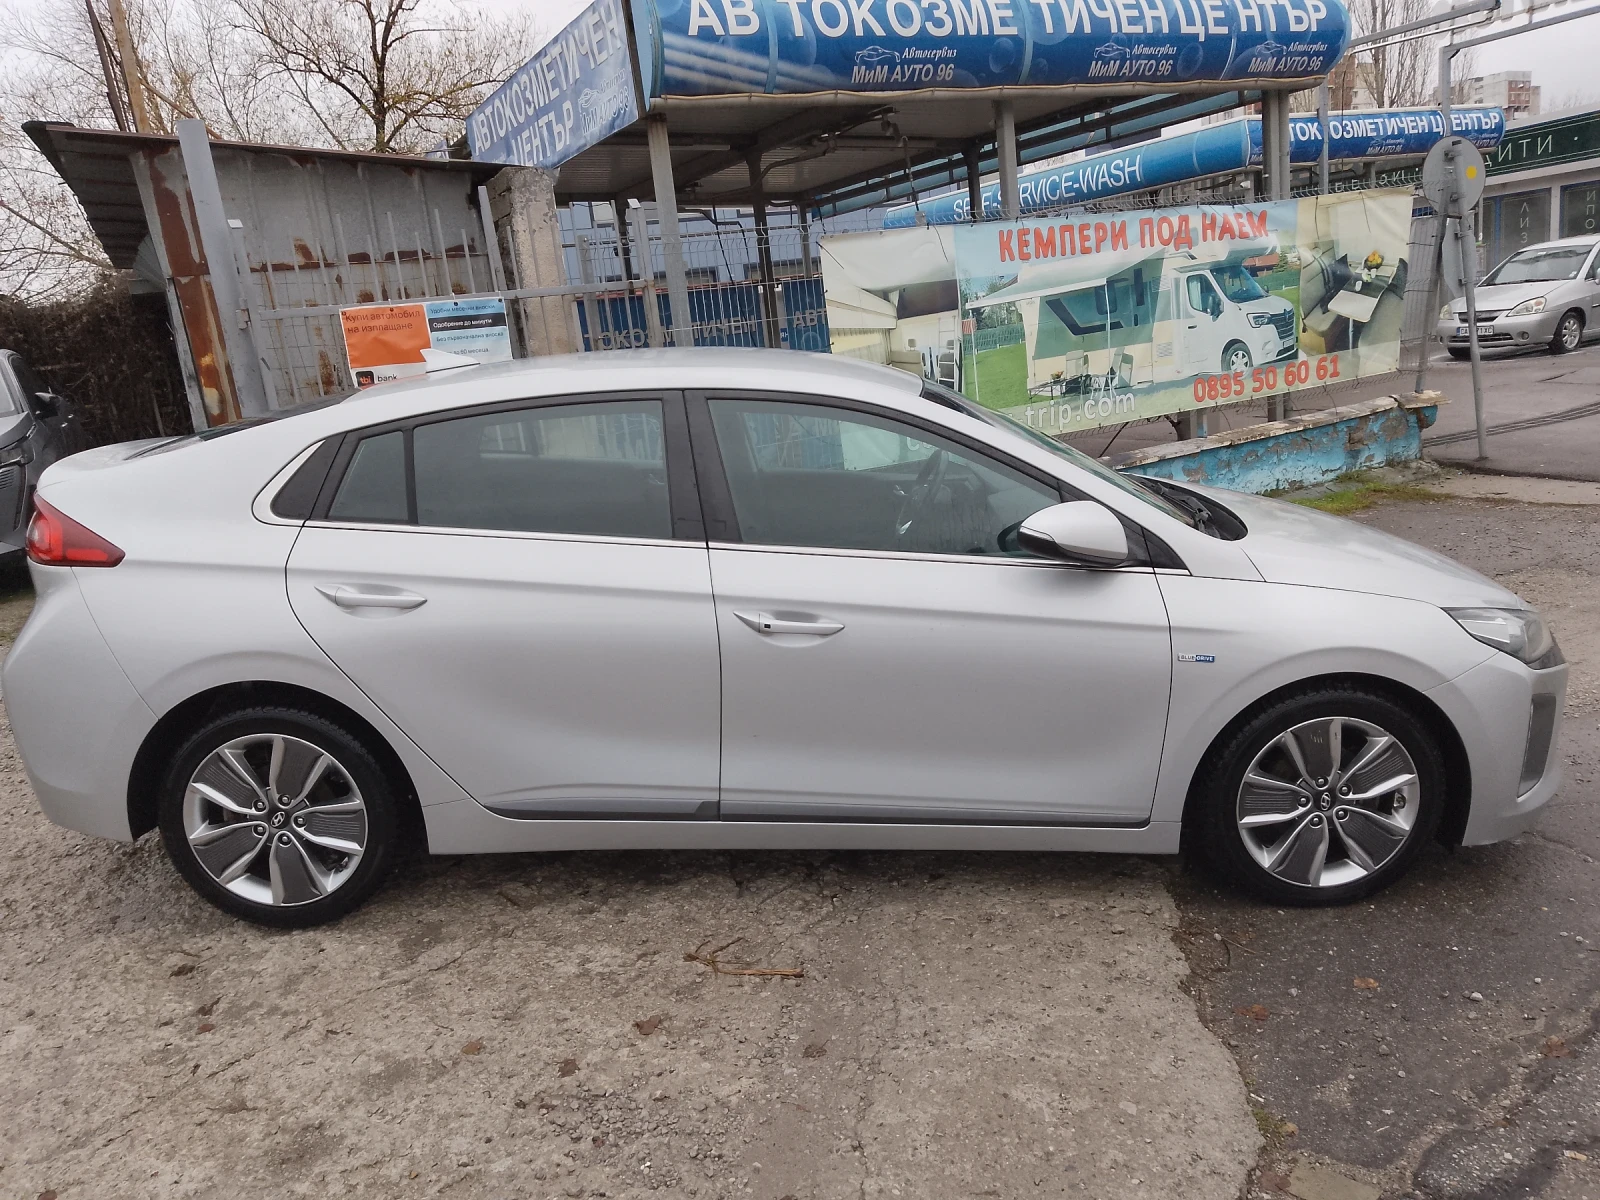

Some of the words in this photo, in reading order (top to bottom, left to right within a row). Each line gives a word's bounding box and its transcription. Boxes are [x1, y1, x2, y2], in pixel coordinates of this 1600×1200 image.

[902, 46, 957, 61] Автосервиз
[1132, 44, 1177, 57] Автосервиз
[1088, 60, 1120, 77] МиМ
[1119, 60, 1157, 76] АУТО
[1157, 59, 1174, 76] 96
[1275, 56, 1309, 72] АУТО
[1308, 56, 1324, 71] 96
[472, 1, 622, 156] АВТОКОЗМЕТИЧЕН
[851, 65, 888, 83] МиМ
[890, 64, 934, 82] АУТО
[936, 63, 955, 81] 96
[512, 100, 574, 166] ЦЕНТЪР
[998, 220, 1128, 262] КЕМПЕРИ
[1139, 214, 1193, 251] ПОД
[1202, 210, 1270, 242] НАЕМ
[345, 314, 368, 323] Купи
[371, 310, 420, 321] автомобил
[347, 326, 360, 334] на
[362, 322, 413, 333] изплащане
[377, 374, 397, 382] bank
[1193, 371, 1245, 402] 0895
[1252, 366, 1278, 393] 50
[1284, 360, 1309, 386] 60
[1316, 354, 1341, 381] 61
